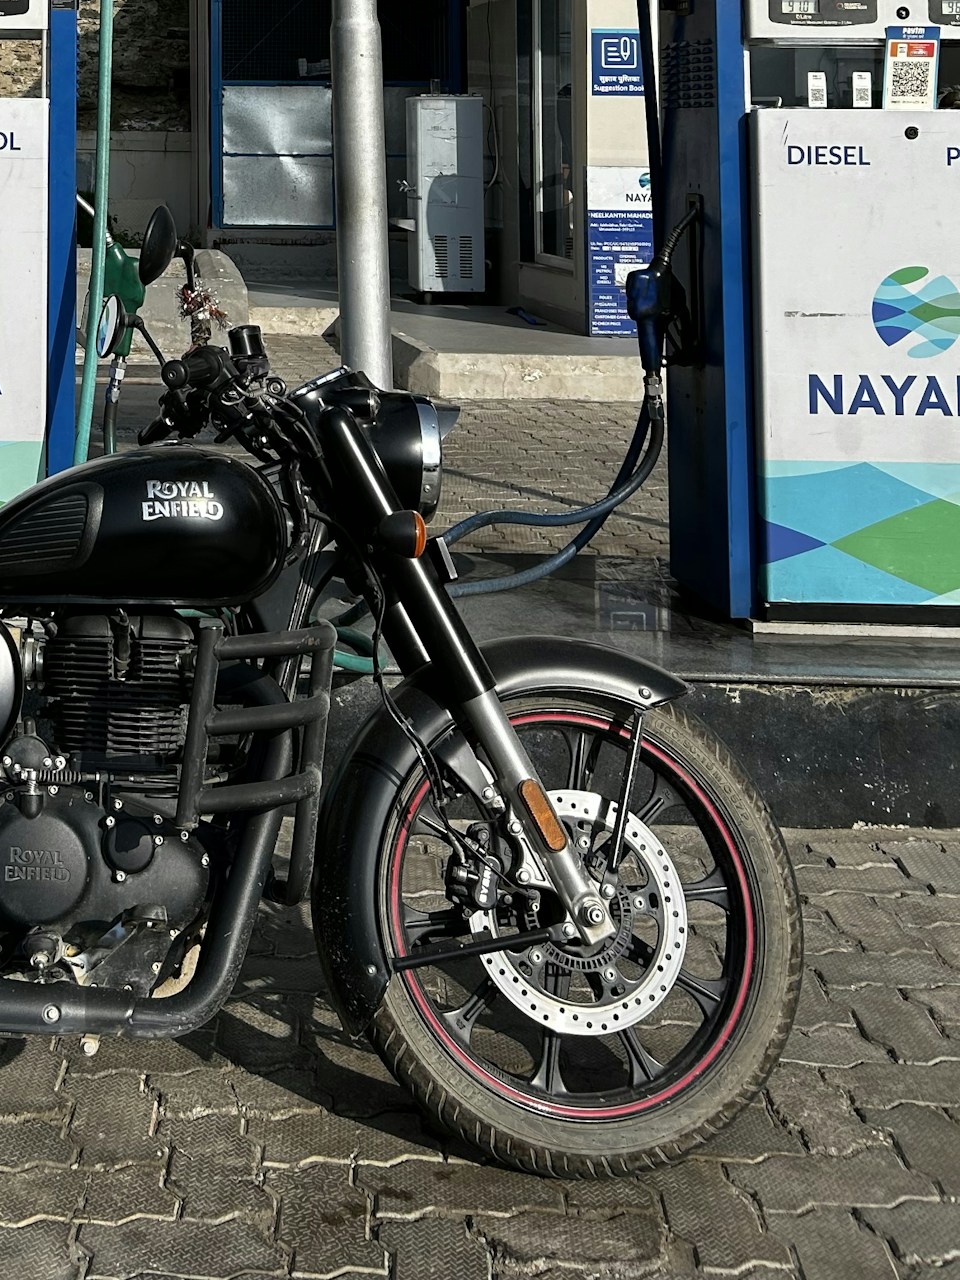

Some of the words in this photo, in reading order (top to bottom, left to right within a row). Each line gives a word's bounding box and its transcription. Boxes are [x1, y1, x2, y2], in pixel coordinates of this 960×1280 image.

[594, 84, 628, 92] Suggestion
[788, 146, 870, 166] DIESEL
[808, 374, 960, 416] NAYA
[146, 480, 214, 499] ROYAL
[142, 501, 224, 520] ENFIELD
[10, 846, 64, 866] ROYAL
[4, 866, 72, 882] ENFIELD
